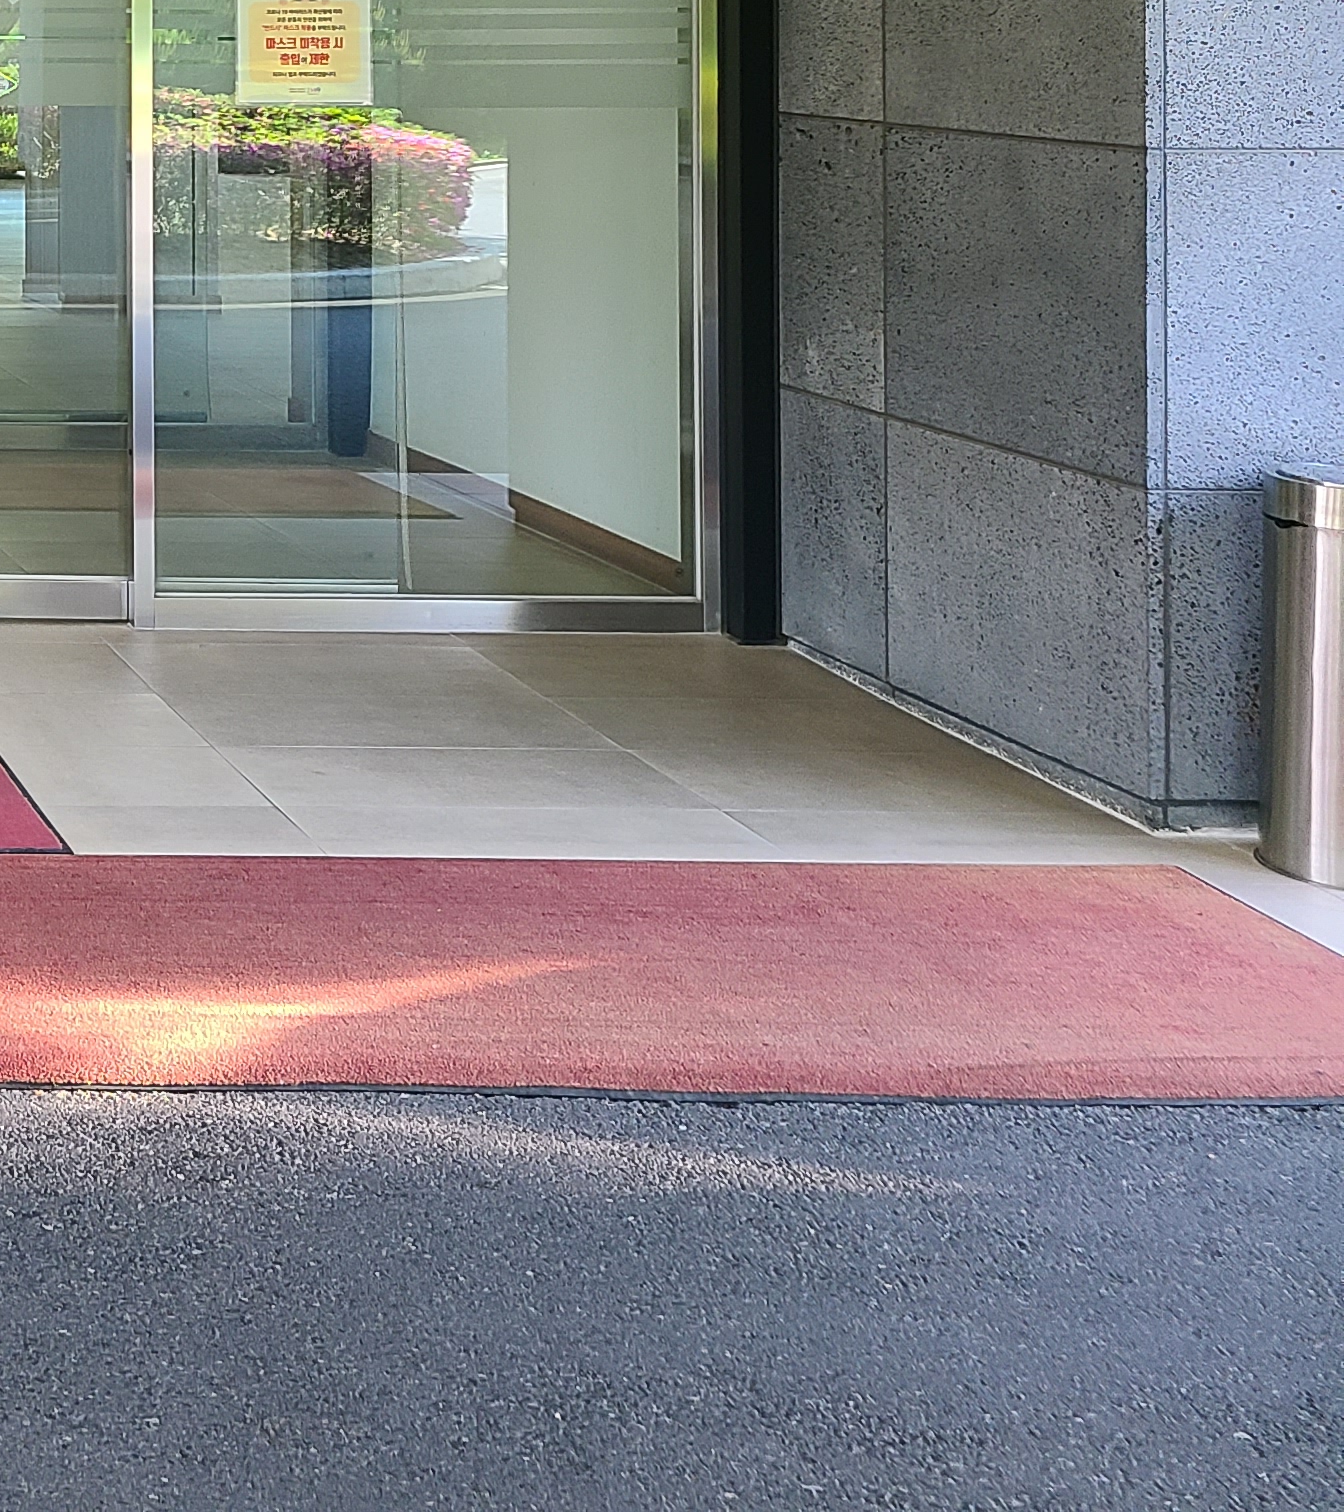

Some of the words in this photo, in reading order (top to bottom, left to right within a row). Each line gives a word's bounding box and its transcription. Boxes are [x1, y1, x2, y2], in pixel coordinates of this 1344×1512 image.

[266, 37, 297, 49] 마스크
[299, 37, 330, 49] 미착용
[332, 37, 343, 49] 시
[309, 53, 330, 65] 제한
